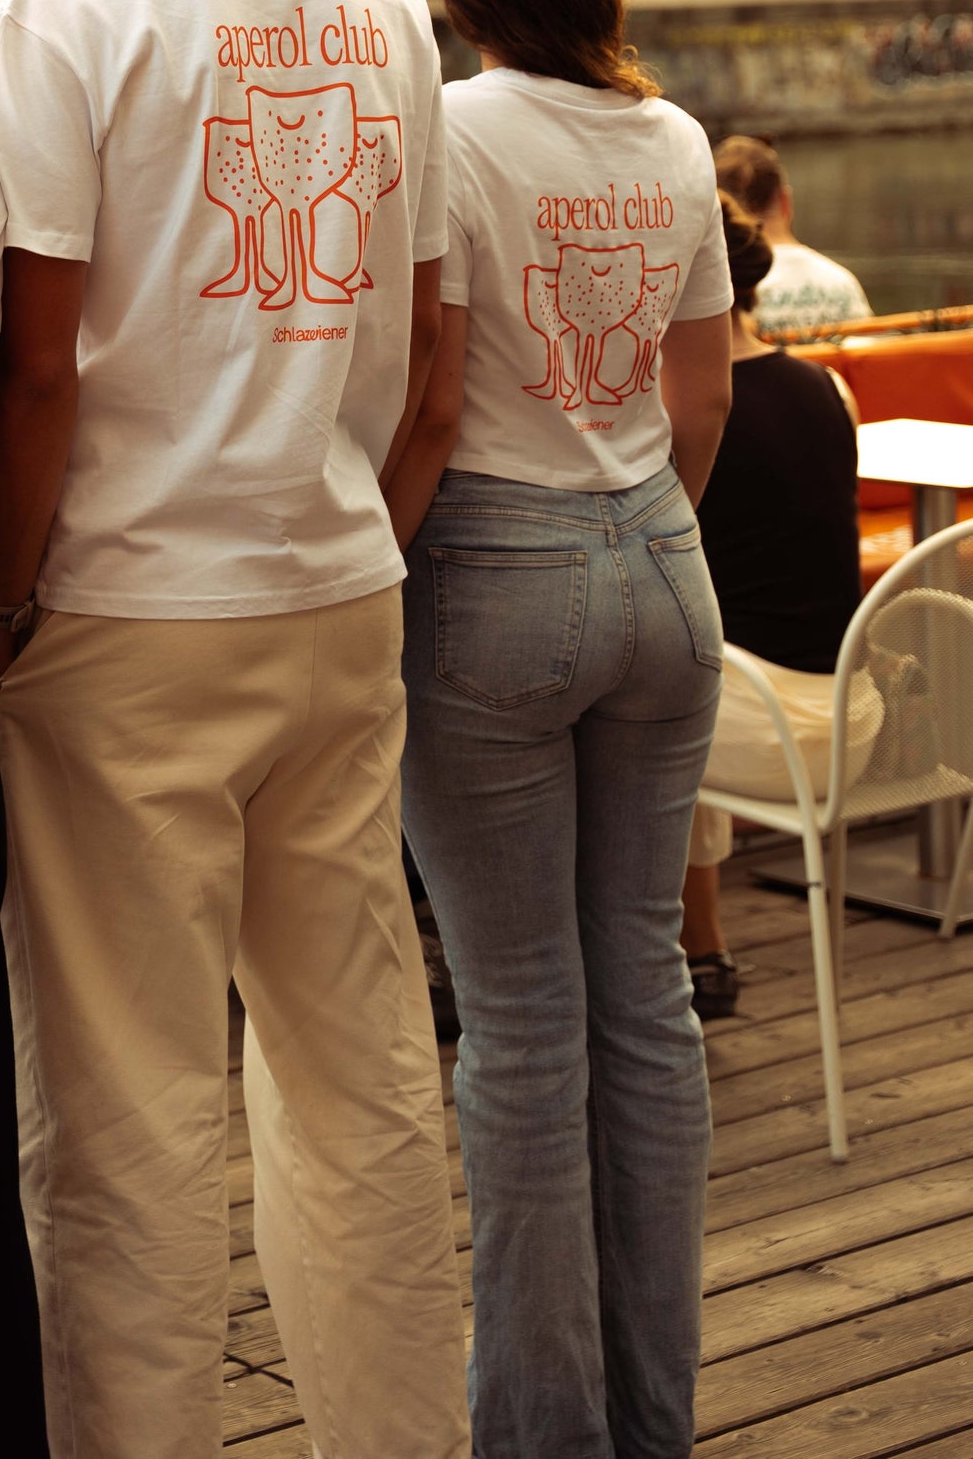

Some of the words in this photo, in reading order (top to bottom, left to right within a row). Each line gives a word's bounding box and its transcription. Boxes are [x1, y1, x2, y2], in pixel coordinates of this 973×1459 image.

[215, 6, 313, 83] aperol
[321, 5, 389, 68] club
[537, 183, 619, 241] aperol
[624, 182, 674, 230] club
[272, 325, 349, 343] Schlawiener
